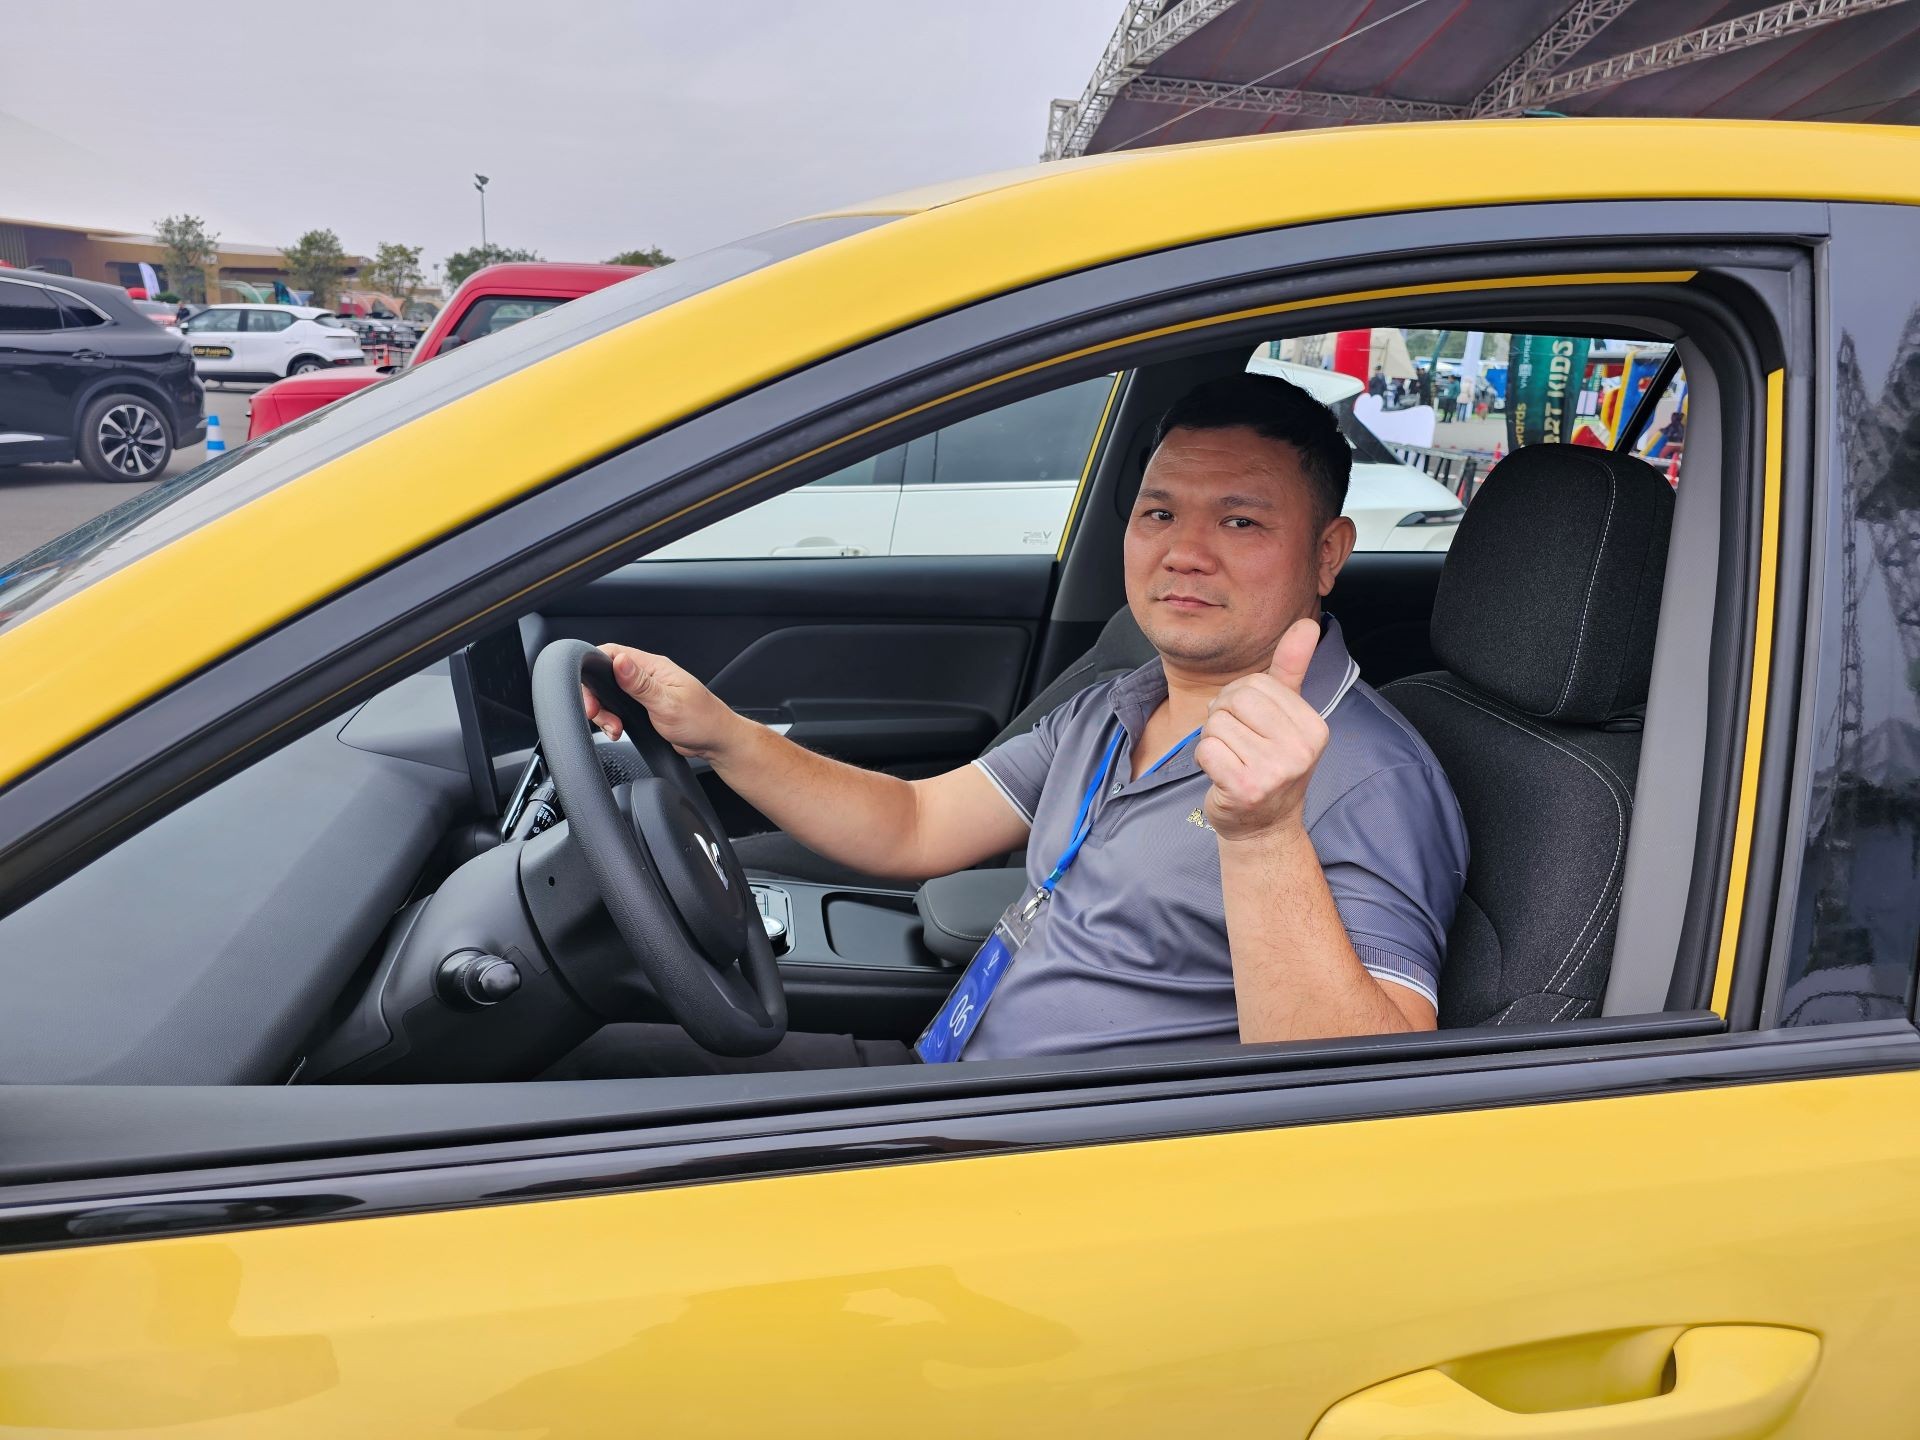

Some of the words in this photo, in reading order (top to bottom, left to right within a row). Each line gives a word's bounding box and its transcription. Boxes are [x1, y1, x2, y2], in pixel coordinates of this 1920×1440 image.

[1547, 339, 1573, 398] KIDS
[1515, 402, 1527, 447] wards
[950, 994, 974, 1038] 06
